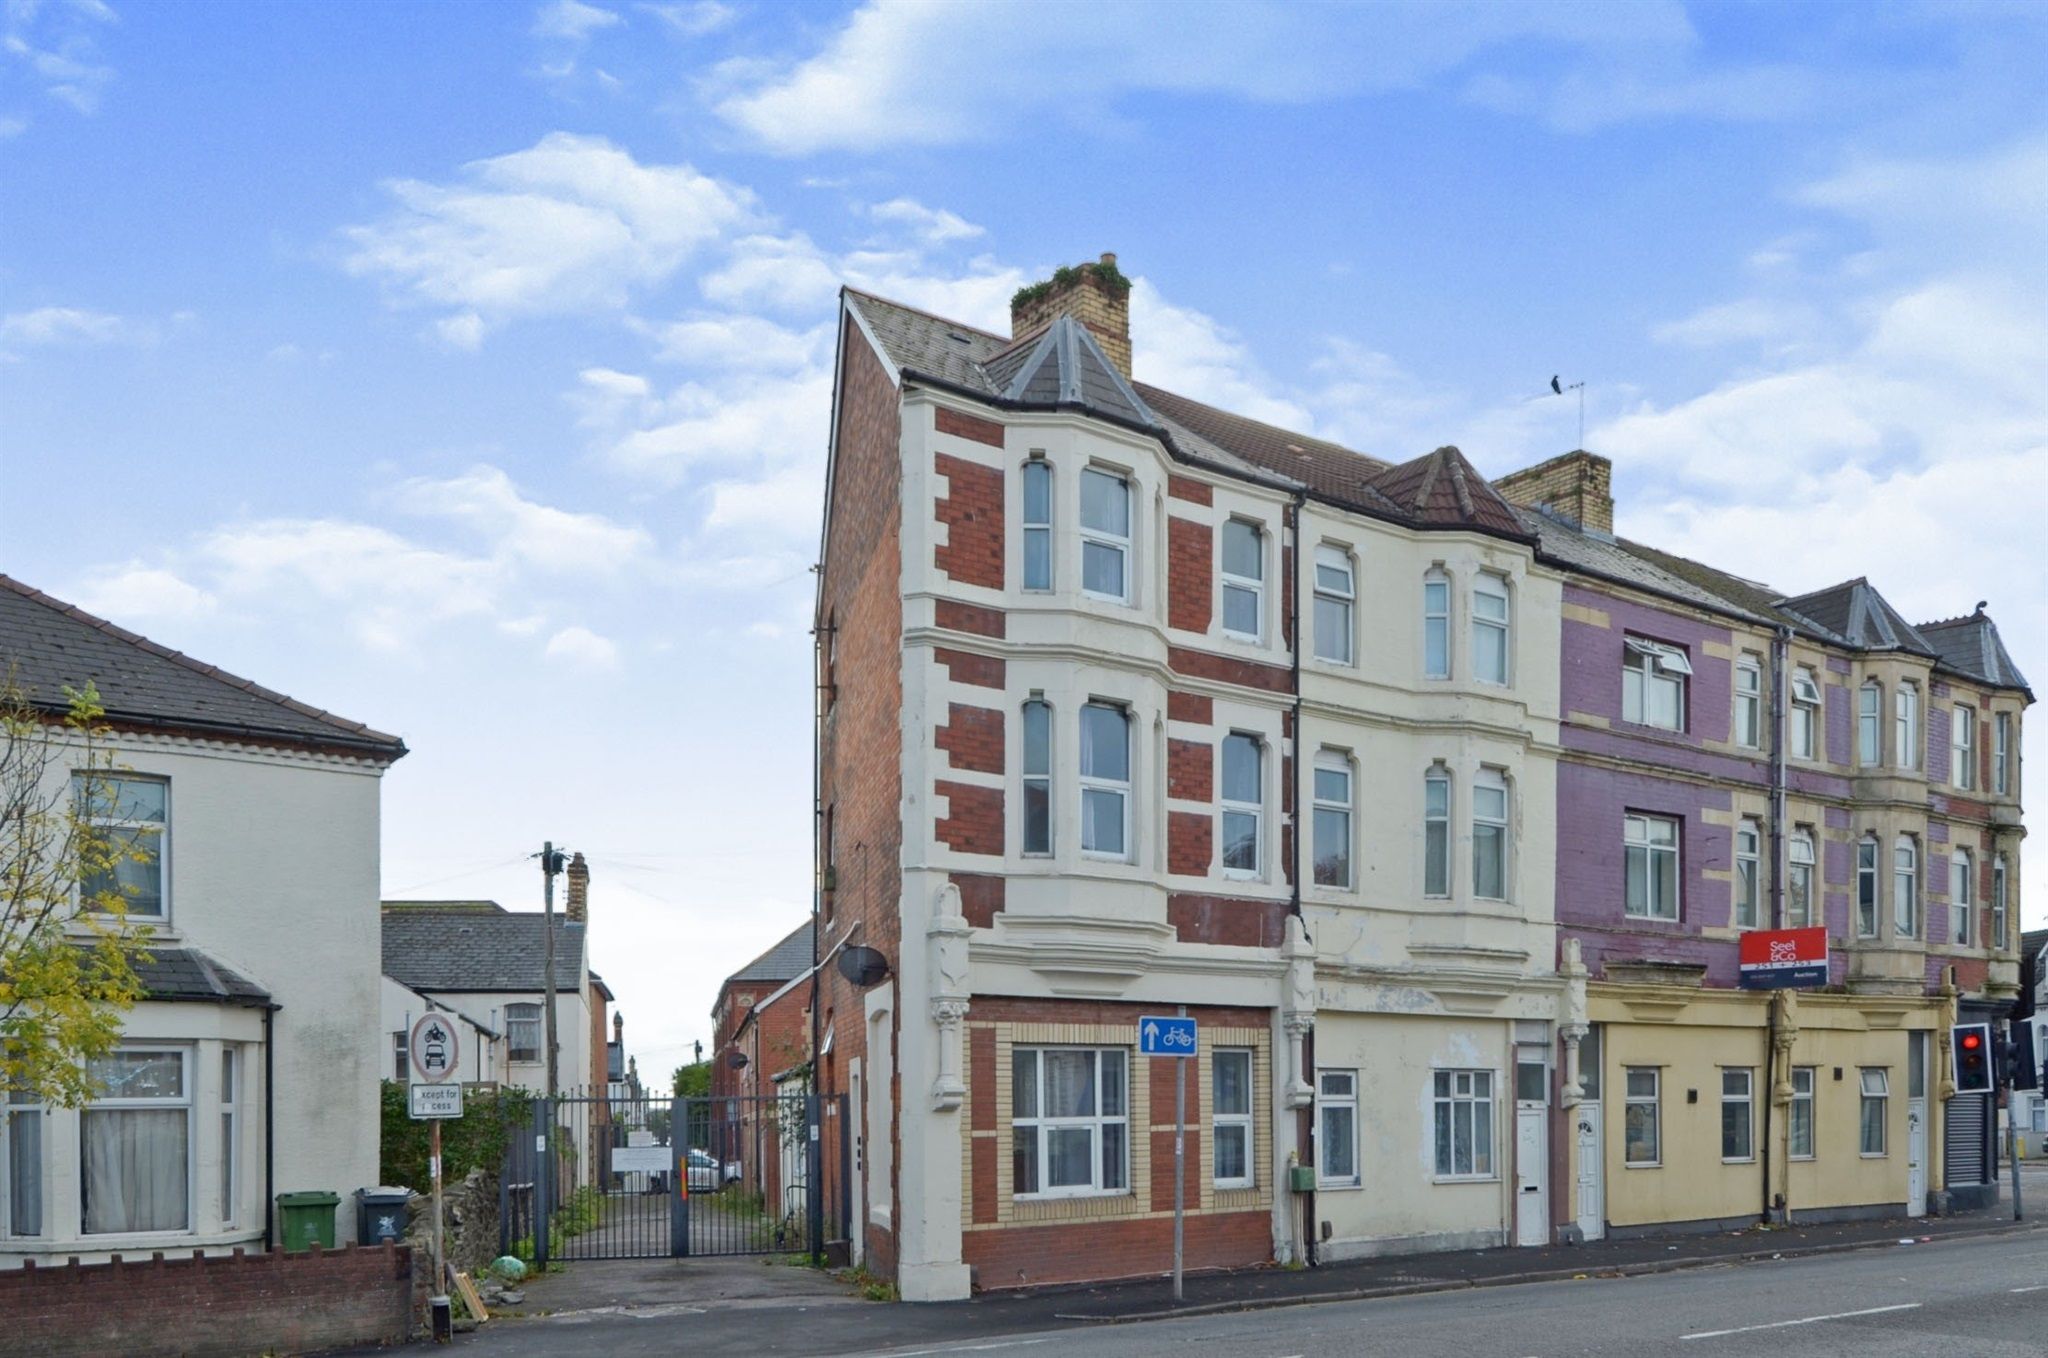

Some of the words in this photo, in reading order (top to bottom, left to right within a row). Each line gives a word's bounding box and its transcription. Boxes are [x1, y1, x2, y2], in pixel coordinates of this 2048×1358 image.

[1770, 940, 1796, 951] Seel
[1770, 951, 1796, 961] &Co
[417, 1091, 444, 1099] xcept
[446, 1090, 456, 1098] for
